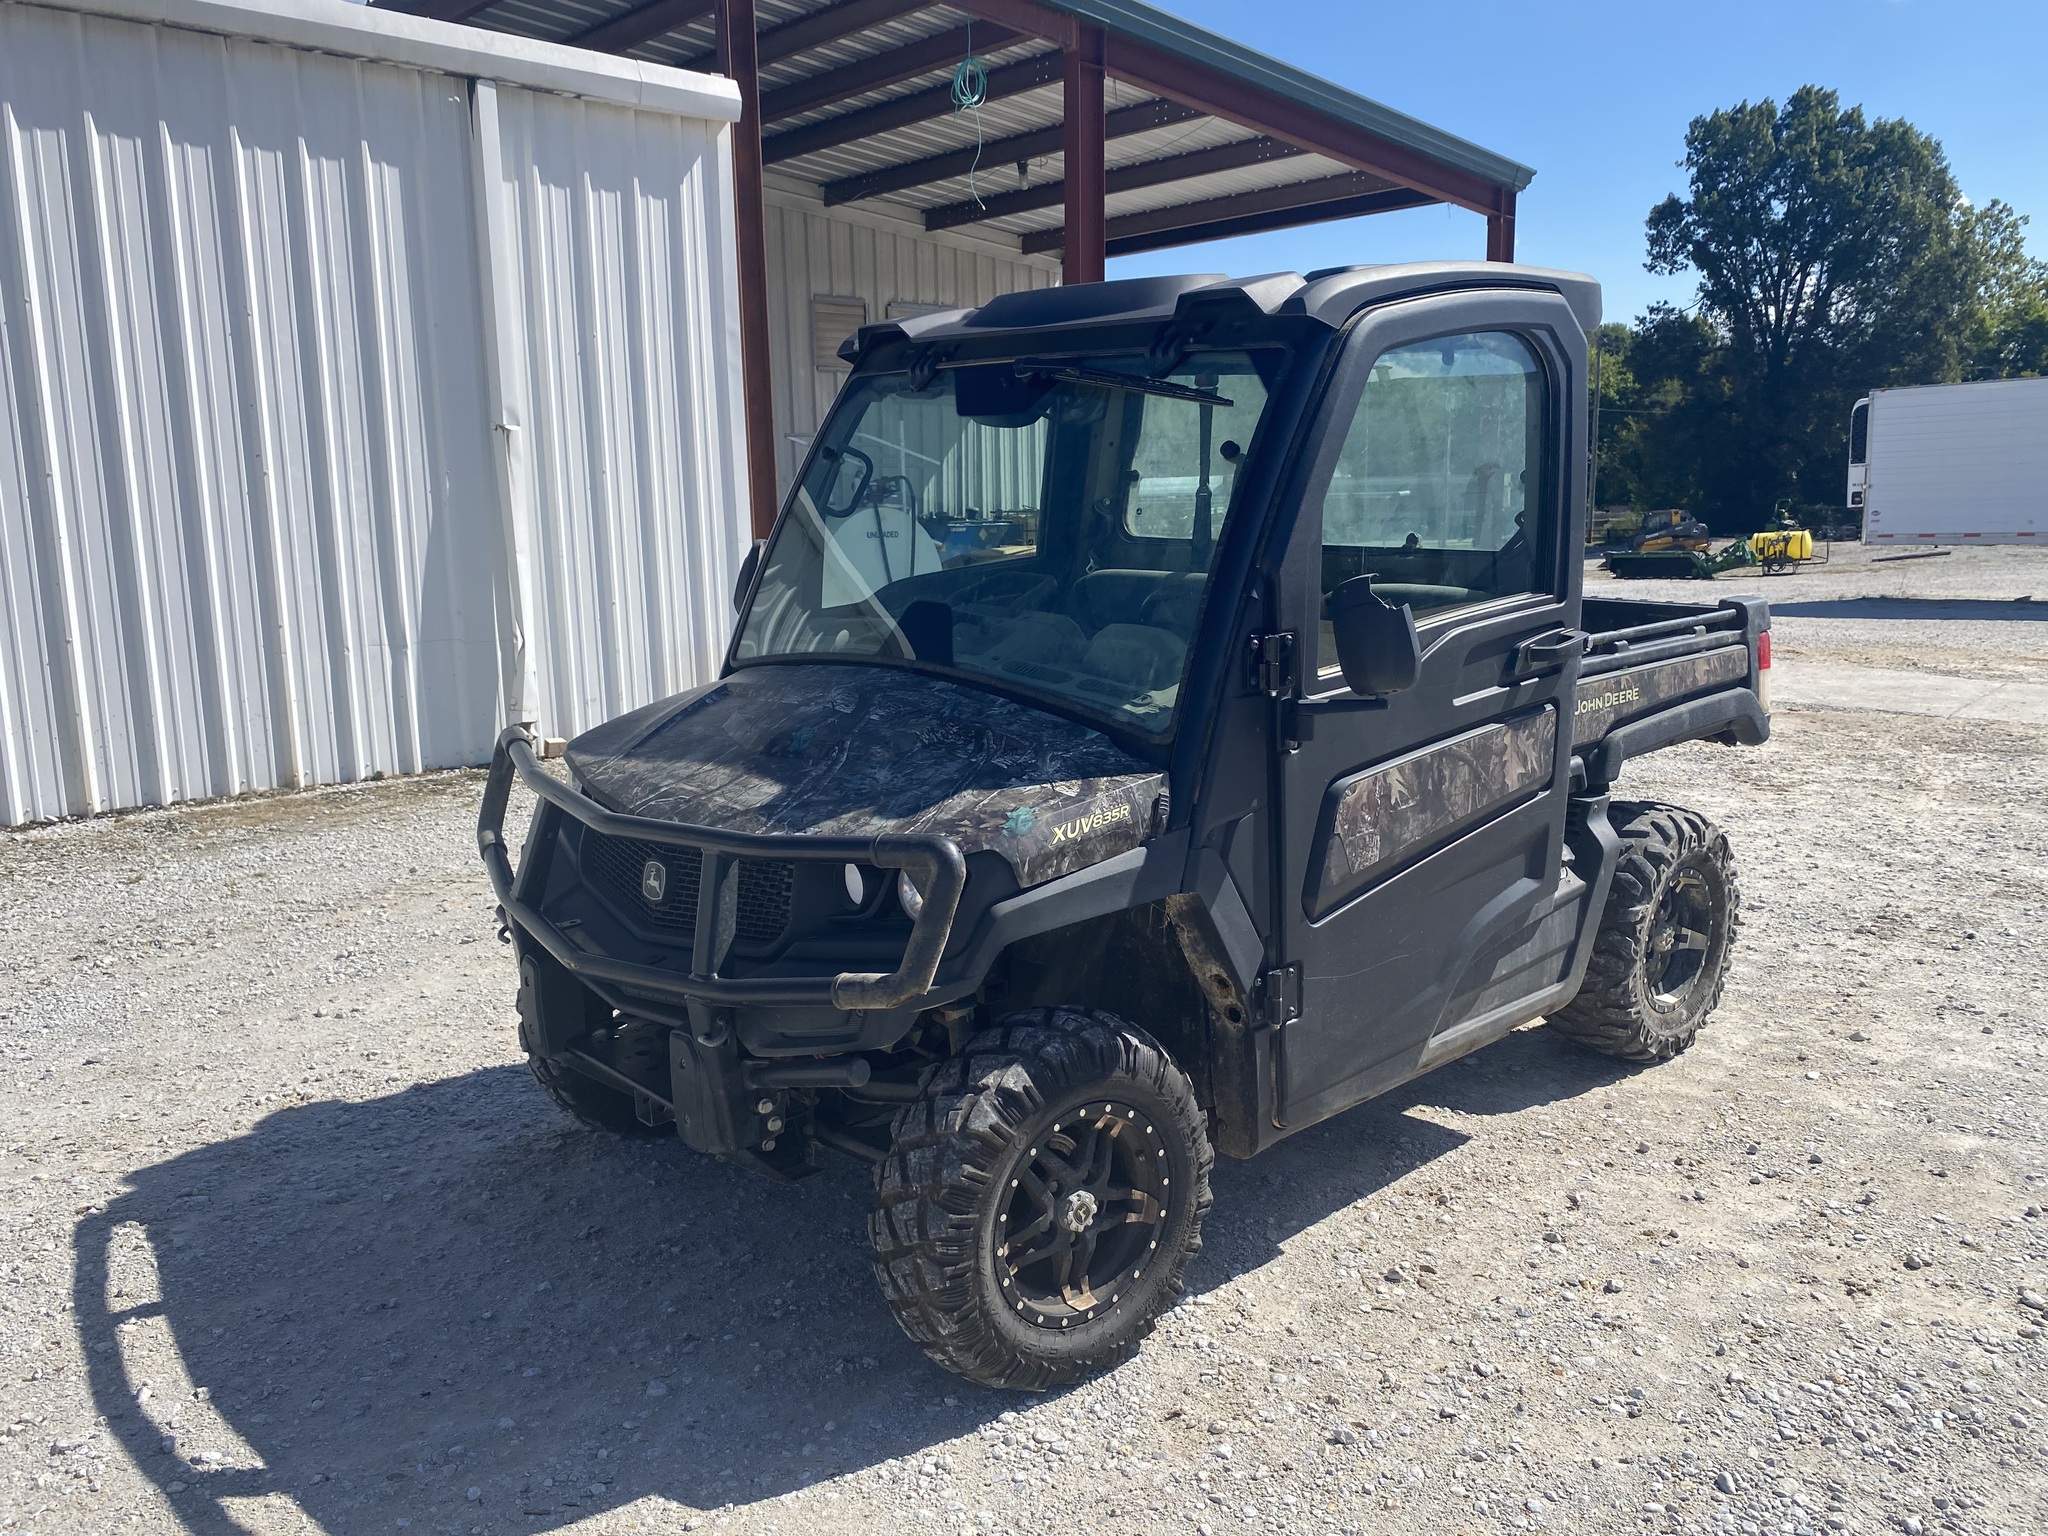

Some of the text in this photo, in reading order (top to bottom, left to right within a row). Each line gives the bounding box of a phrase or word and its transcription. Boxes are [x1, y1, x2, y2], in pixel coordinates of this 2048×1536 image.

[866, 531, 899, 539] UNLADED
[1574, 688, 1640, 716] JOHN DEERE
